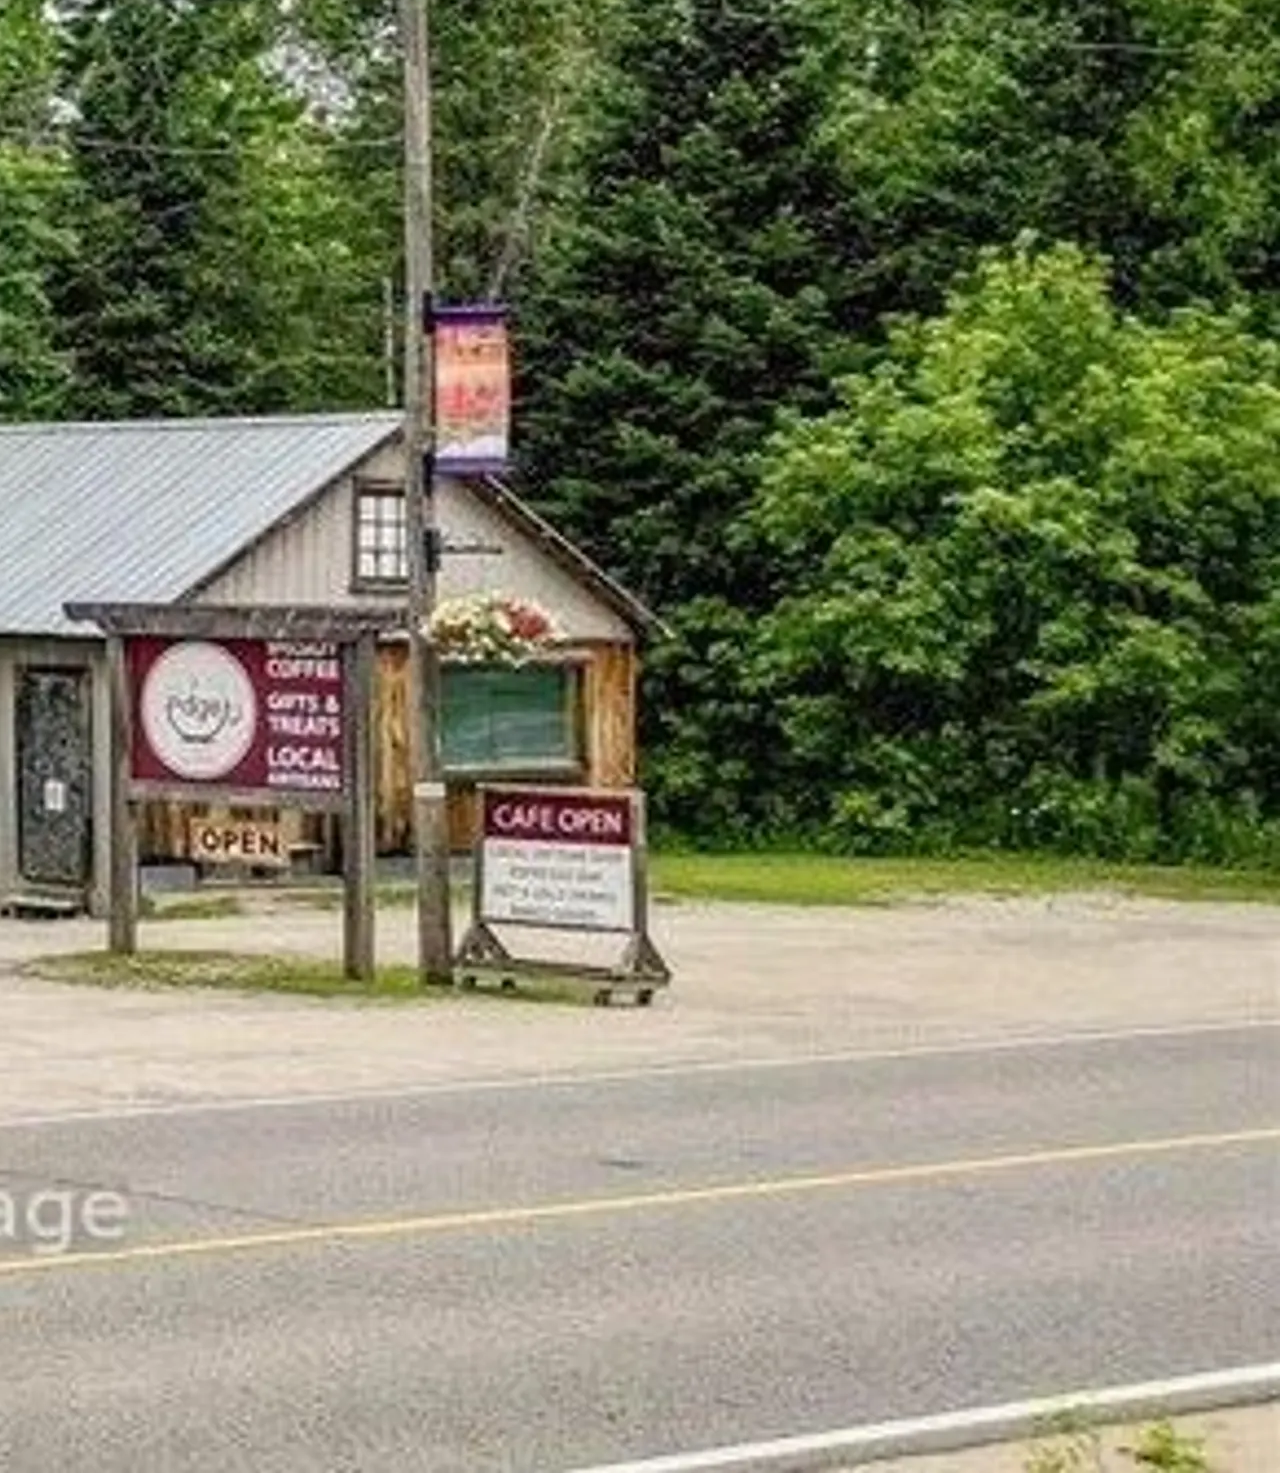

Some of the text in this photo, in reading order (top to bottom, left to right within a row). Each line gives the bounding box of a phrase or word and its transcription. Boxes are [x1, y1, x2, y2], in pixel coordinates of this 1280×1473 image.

[267, 658, 339, 679] COFFEE
[268, 691, 339, 714] GIFTS &
[268, 715, 340, 737] TREATS
[268, 745, 340, 771] LOCAL
[558, 807, 623, 834] OPEN
[201, 827, 279, 855] OPEN
